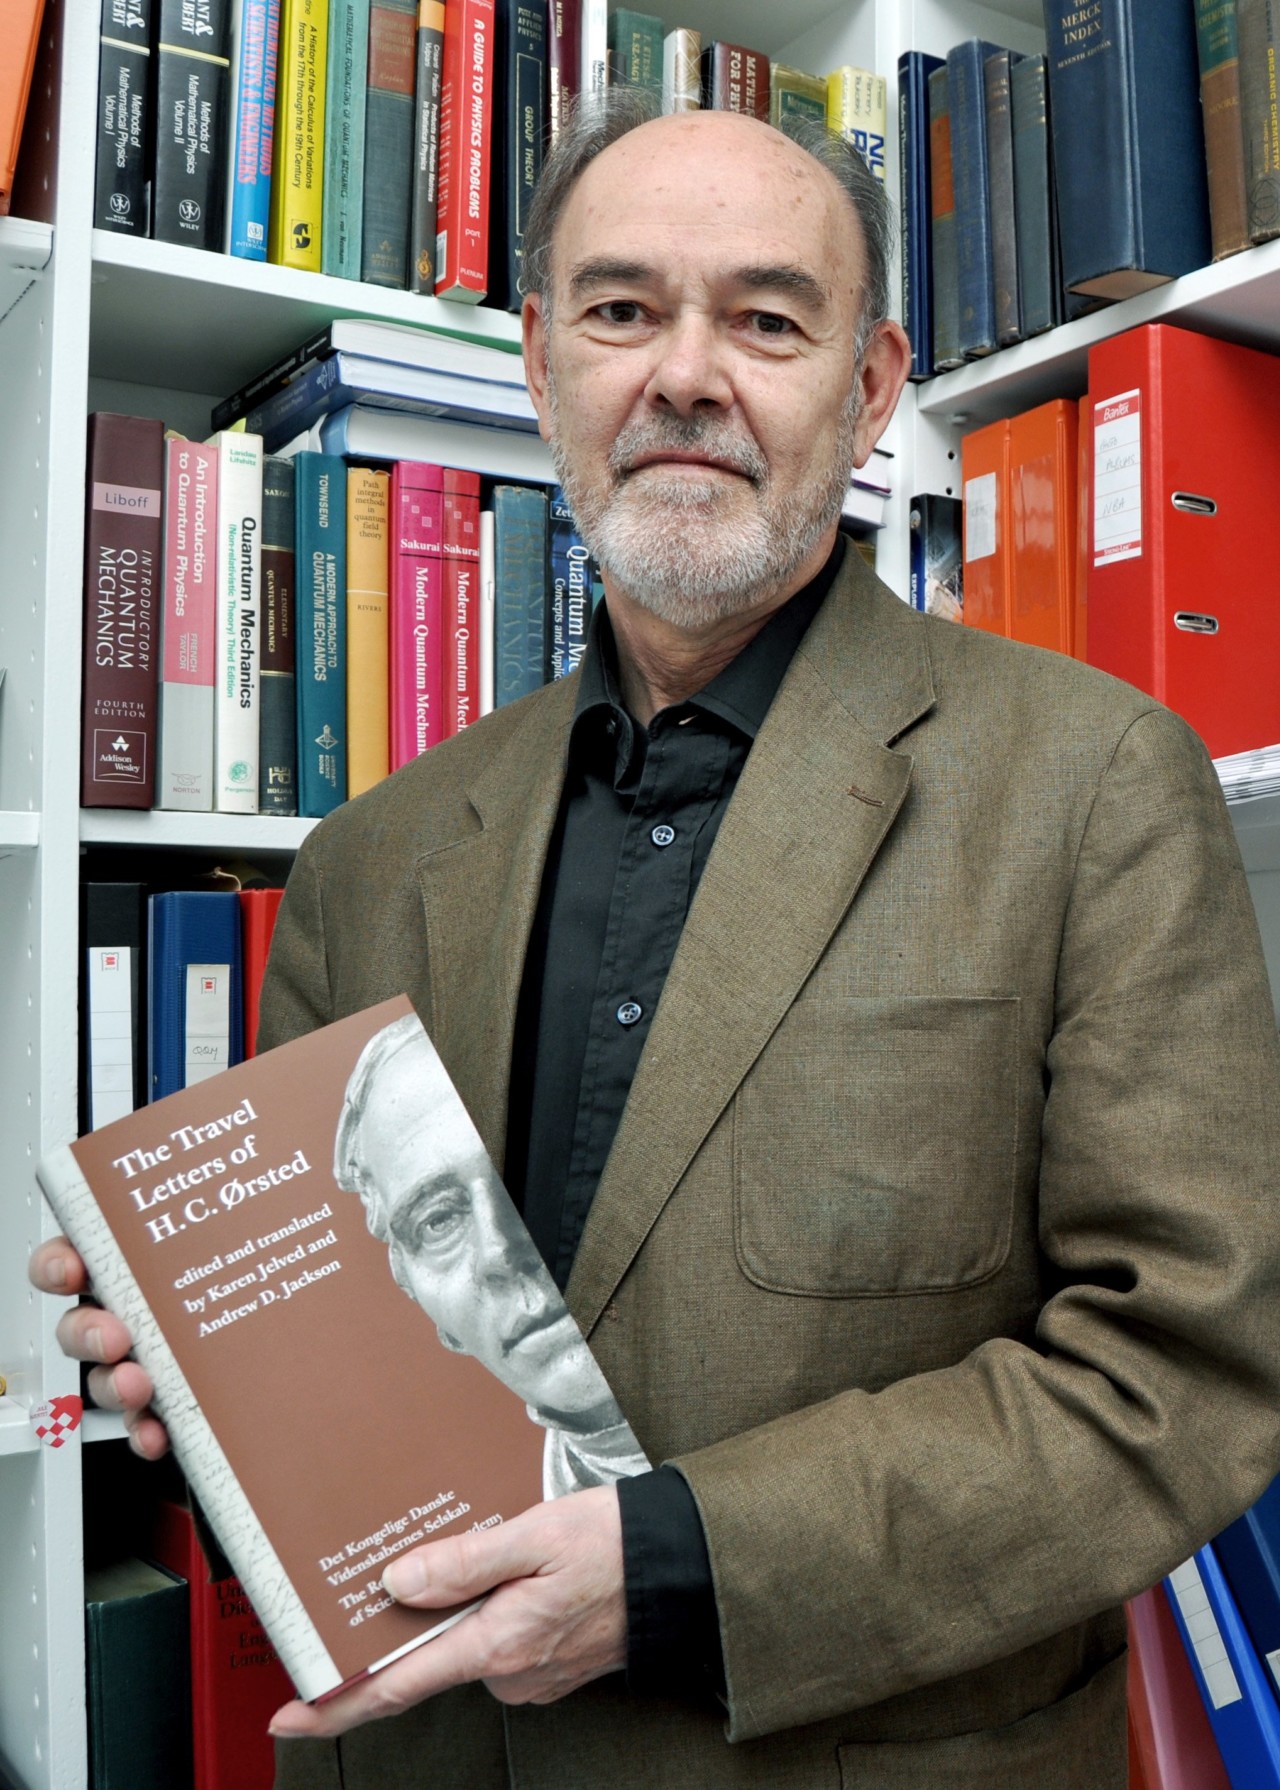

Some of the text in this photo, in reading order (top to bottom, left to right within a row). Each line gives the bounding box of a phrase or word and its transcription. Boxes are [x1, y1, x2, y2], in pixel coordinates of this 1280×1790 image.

[1062, 4, 1101, 29] MERCK
[1064, 20, 1102, 45] INDEX
[174, 100, 185, 136] Volume
[186, 74, 199, 174] Mathematical Physics
[200, 101, 212, 154] Methods of
[469, 19, 485, 219] A GUIDE TO PHYSICS PROBLEMS
[1268, 48, 1280, 170] ORGANIC CHEMISTRY
[525, 105, 534, 187] GROUP THEORY
[180, 222, 199, 231] WILEY
[460, 267, 483, 280] PLENUM
[105, 493, 149, 508] Liboff
[194, 456, 209, 583] An Introduction
[319, 474, 328, 528] TOWNSEND
[176, 452, 190, 617] to Quantum Physics
[401, 539, 440, 552] Sakurai
[444, 543, 480, 556] Sakurai
[96, 546, 116, 667] MECHANICS
[116, 549, 138, 668] QUANTUM
[139, 550, 152, 671] INTRODUCTORY
[327, 563, 336, 601] MODERN
[416, 567, 428, 620] Modern
[240, 516, 257, 709] Quantum Mechanics
[313, 552, 327, 682] QUANTUM MECHANICS
[328, 604, 336, 652] APPROACH
[227, 637, 235, 661] Third
[328, 653, 337, 668] TO
[413, 624, 428, 689] Quantum
[97, 700, 144, 710] FOURTH
[227, 664, 235, 698] Edition
[95, 708, 145, 718] EDITION
[100, 754, 132, 764] Addison
[114, 762, 140, 772] Wesley
[114, 1099, 258, 1179] The Travel
[130, 1134, 259, 1212] Letters of
[220, 1150, 312, 1211] Ørsted
[173, 1203, 333, 1291] edited and translated
[184, 1230, 338, 1314] by Karen Jelved and
[199, 1259, 342, 1338] Andrew D. Jackson
[319, 1489, 456, 1572] Det Kongelige Danske
[328, 1501, 470, 1587] Videnskabernes Selskab
